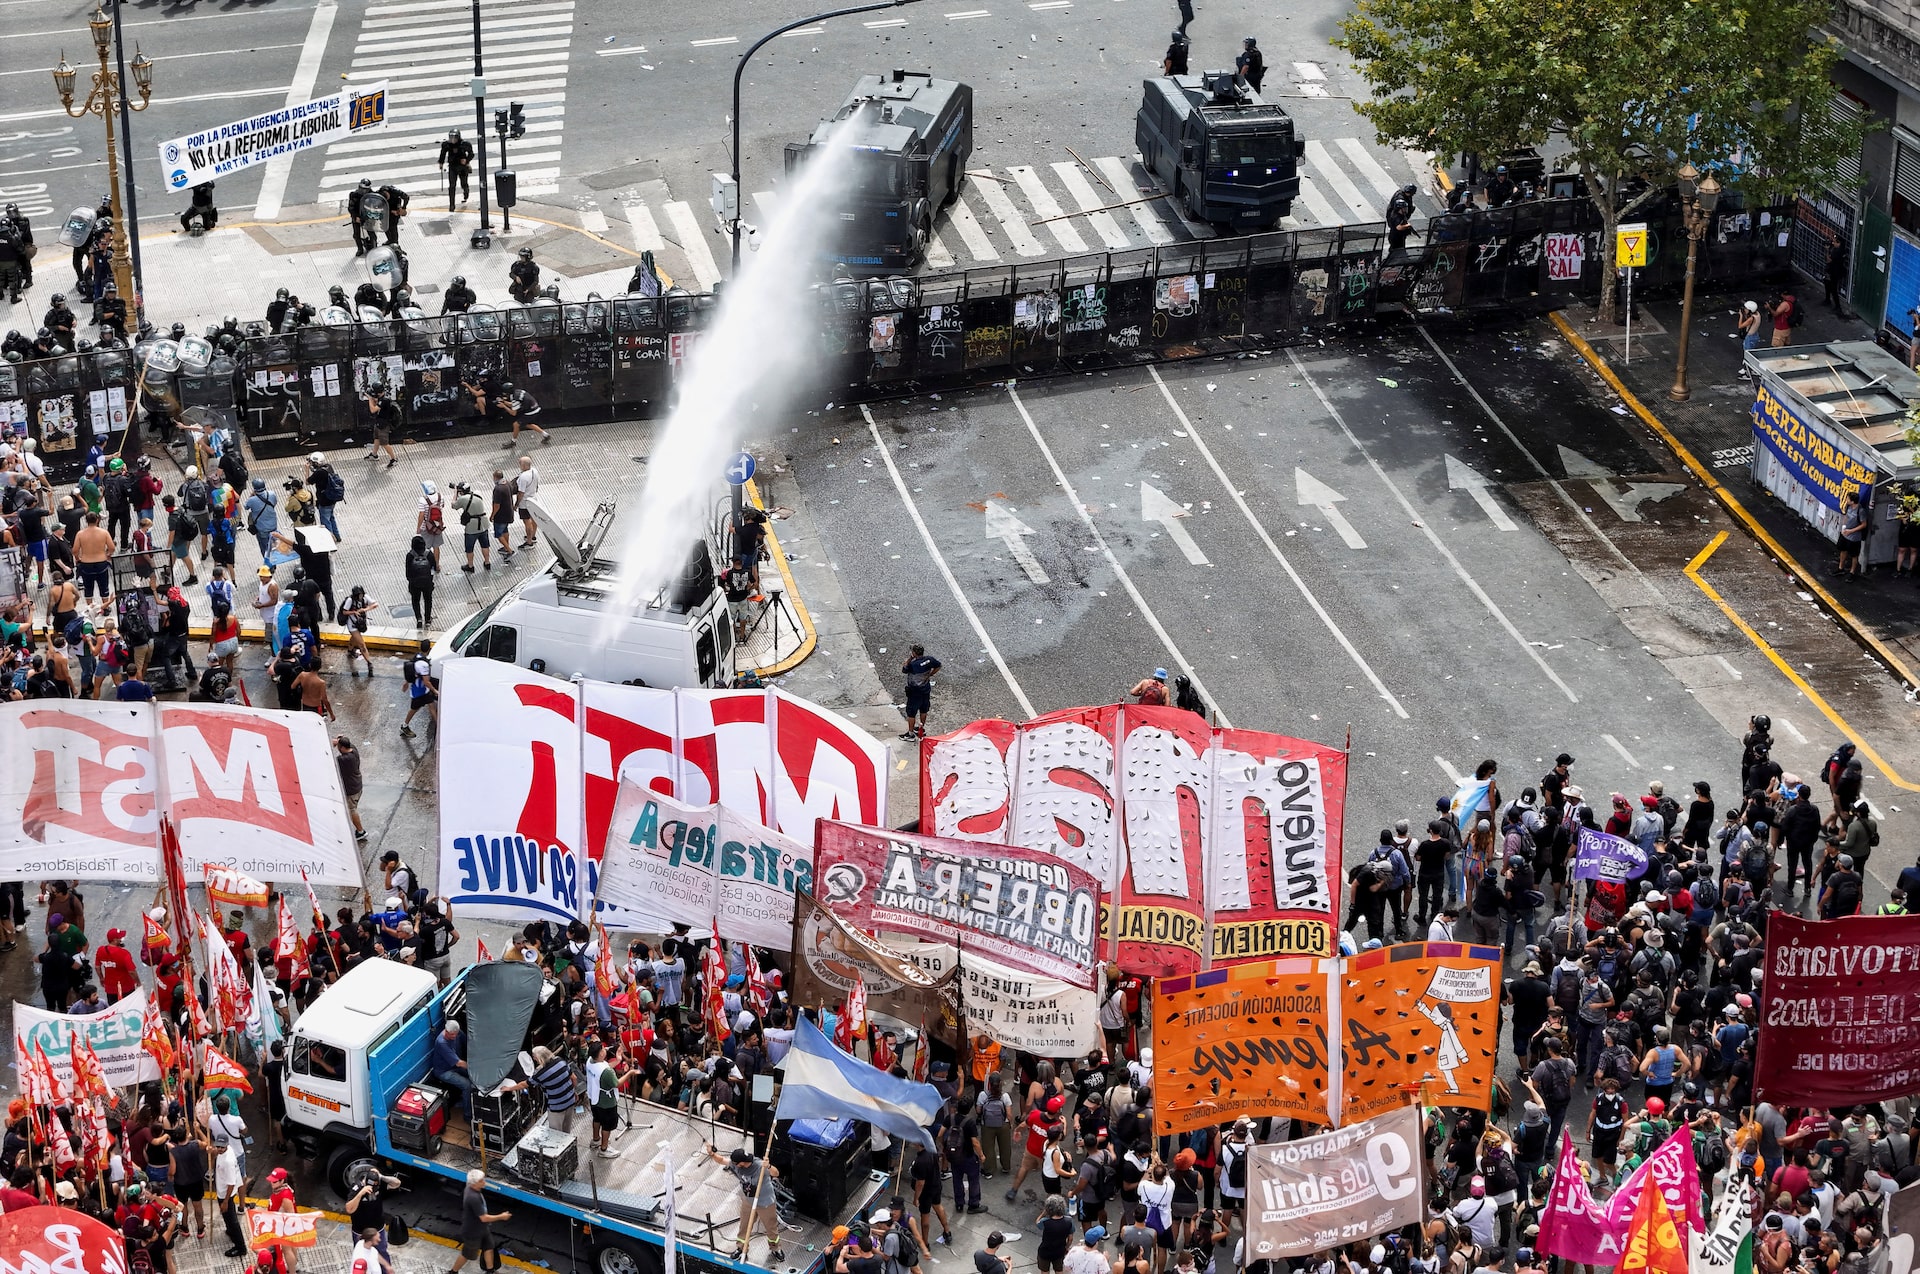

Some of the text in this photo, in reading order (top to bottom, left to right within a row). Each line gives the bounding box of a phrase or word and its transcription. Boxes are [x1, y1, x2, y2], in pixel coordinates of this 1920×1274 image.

[187, 134, 205, 149] POR
[207, 130, 219, 143] LA
[221, 122, 250, 139] PLENA
[292, 106, 308, 121] DEL
[318, 100, 329, 112] 14
[188, 110, 342, 171] NO A LA REFORMA LABORAL
[255, 137, 313, 161] ZELARAYAN
[1065, 316, 1107, 334] NUESTRA
[1756, 384, 1807, 449] FUERZA
[1824, 476, 1842, 498] VOS
[288, 1086, 341, 1113] Grama
[258, 1213, 317, 1239] mas
